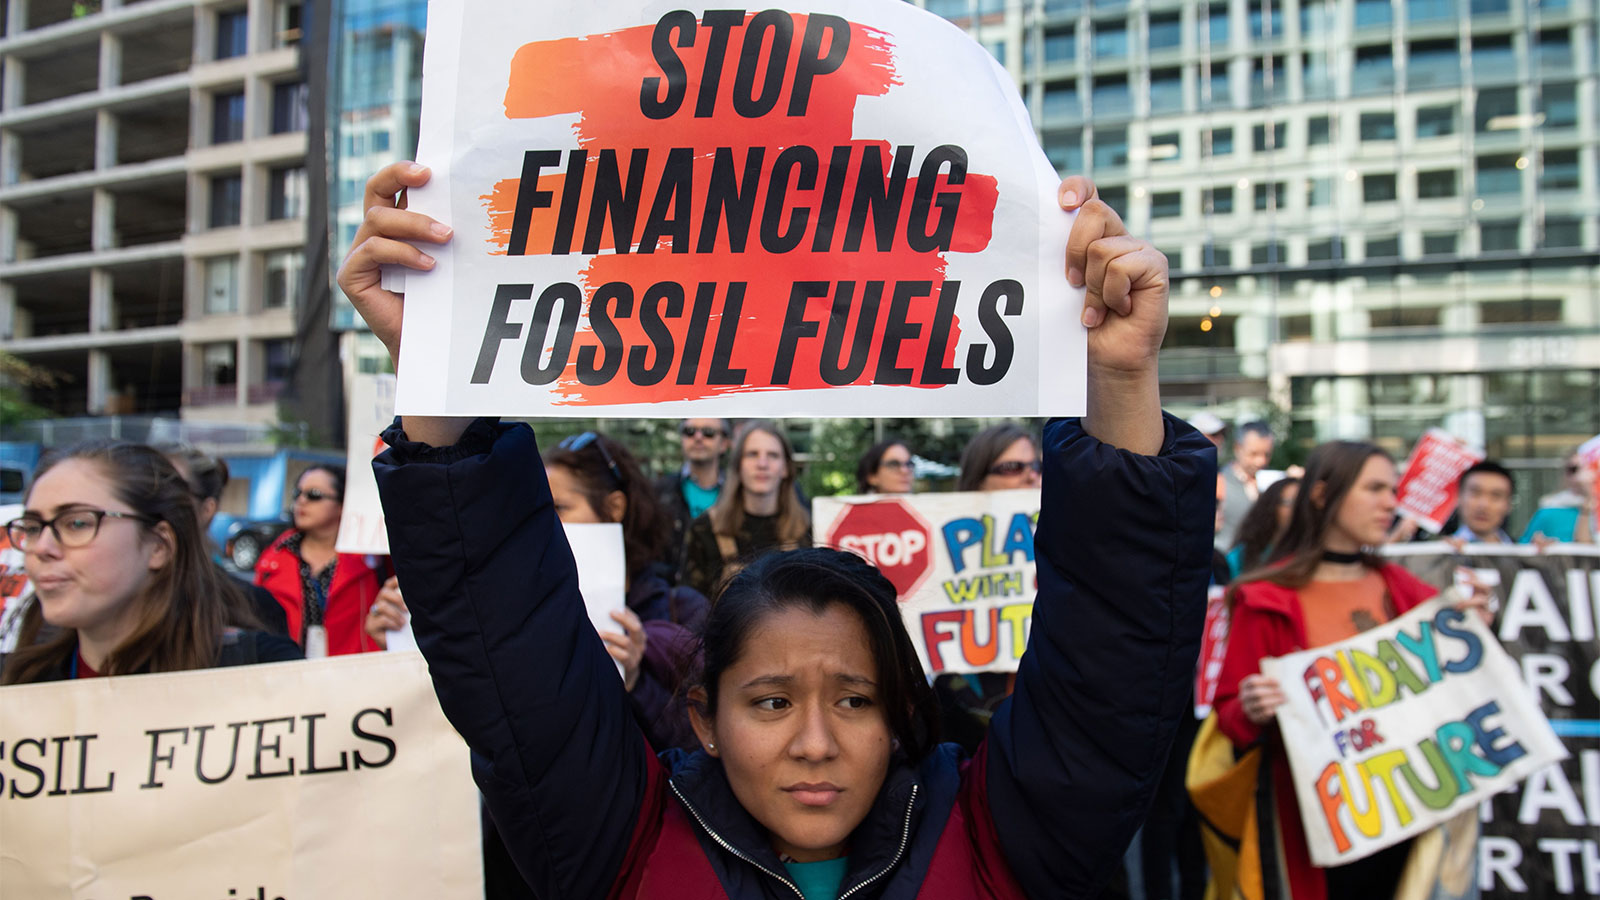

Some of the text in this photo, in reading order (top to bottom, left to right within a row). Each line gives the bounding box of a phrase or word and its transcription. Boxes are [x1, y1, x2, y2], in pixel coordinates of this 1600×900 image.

[640, 9, 851, 119] STOP
[507, 144, 968, 256] FINANCING
[470, 279, 1024, 386] FOSSIL FUELS
[942, 511, 1040, 574] PLA
[943, 571, 1023, 604] WITH
[1303, 608, 1484, 729] FRIDAYS
[0, 707, 397, 799] SIL FUELS
[1315, 700, 1528, 855] FUTURE
[1333, 719, 1385, 757] FOR
